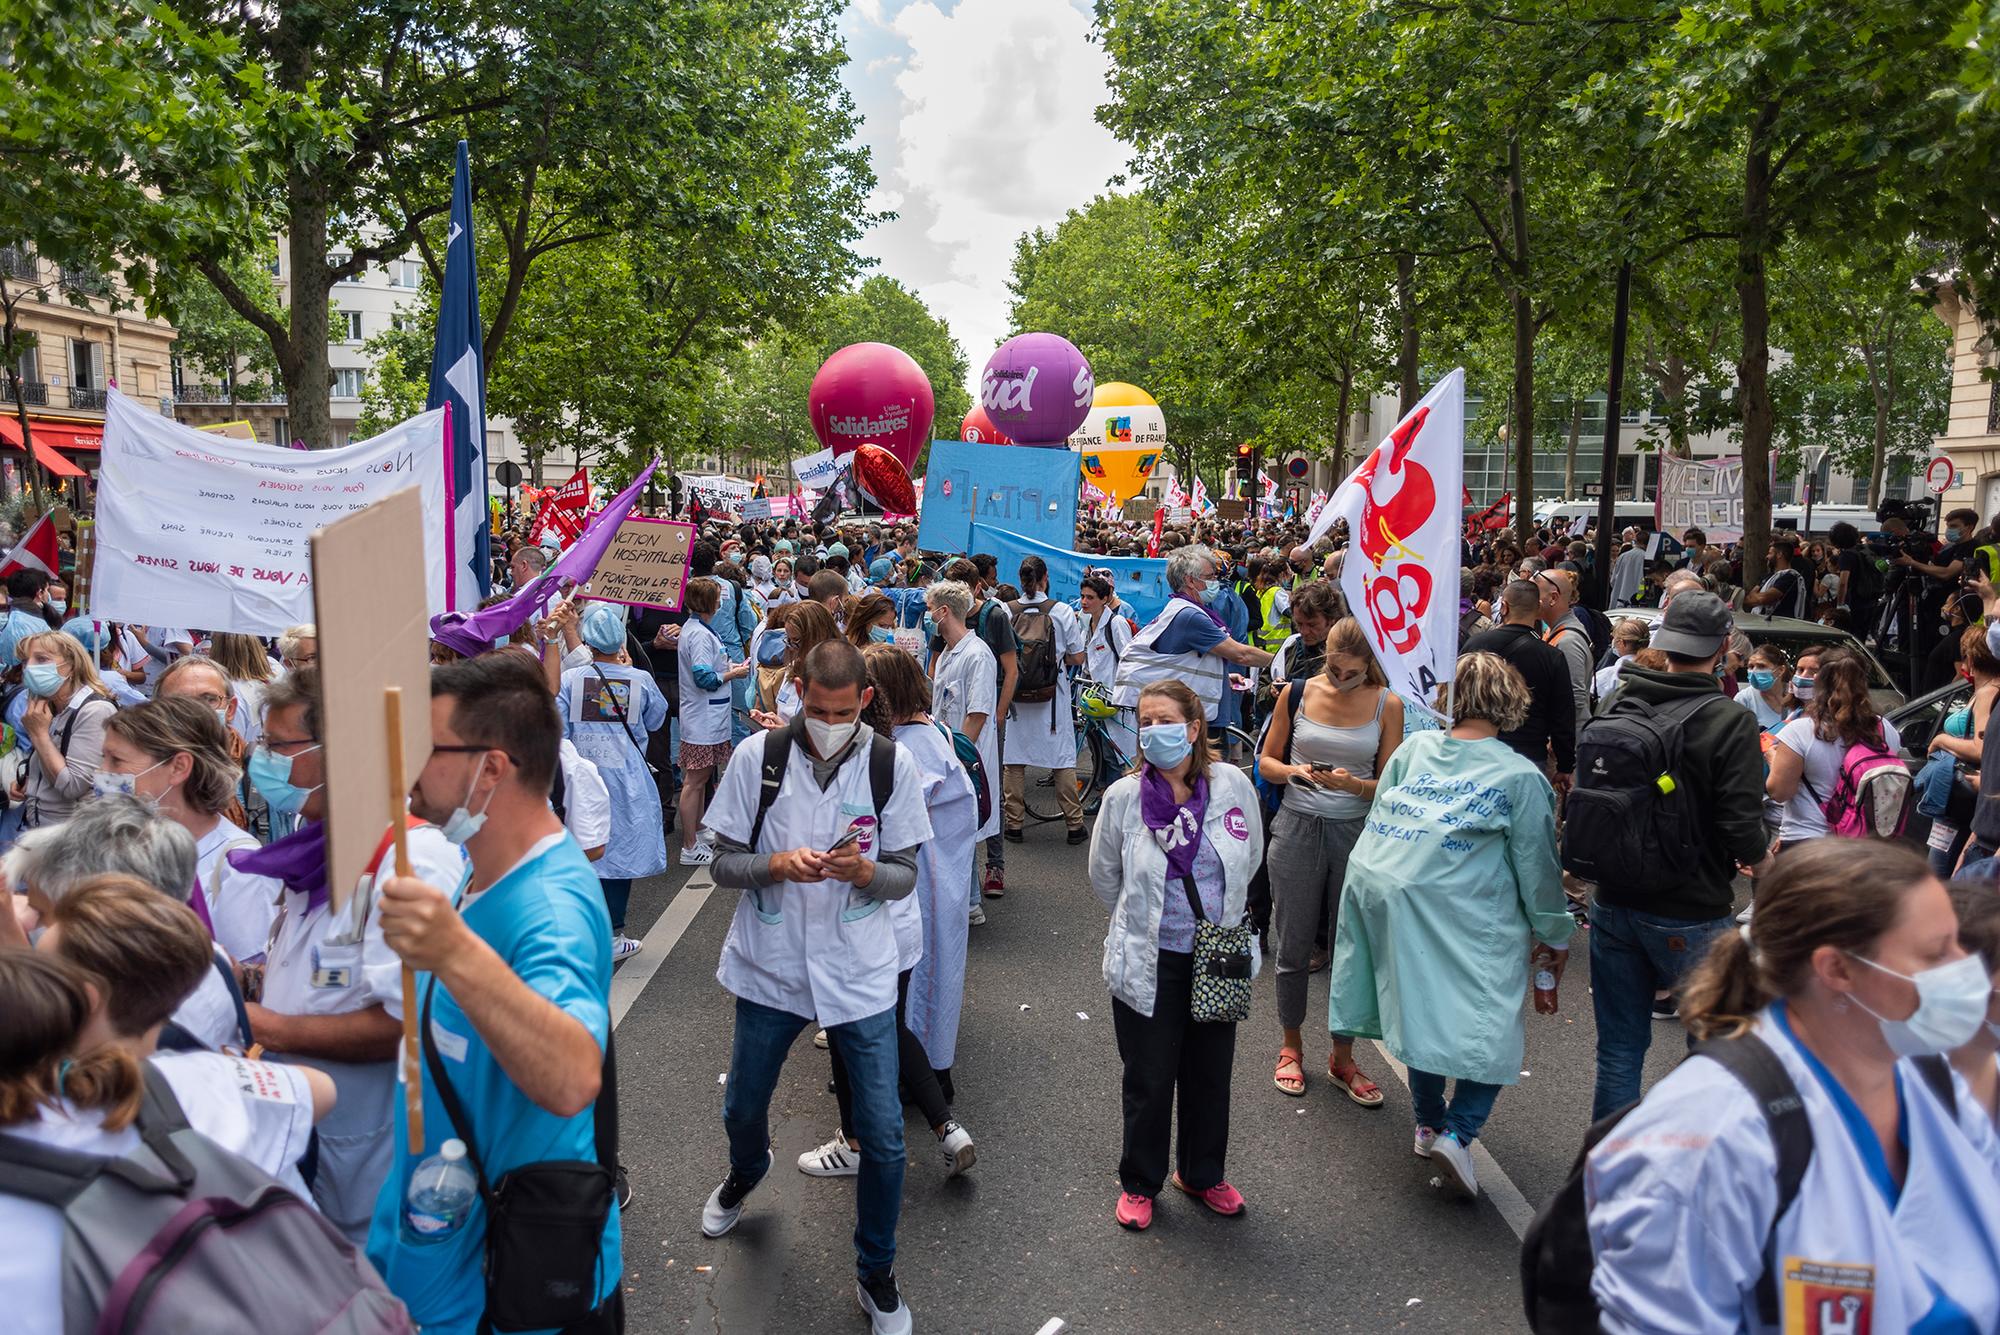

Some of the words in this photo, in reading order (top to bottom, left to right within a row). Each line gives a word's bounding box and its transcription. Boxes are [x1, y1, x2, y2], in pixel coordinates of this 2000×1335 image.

[829, 415, 908, 435] Solidaires
[1149, 422, 1158, 431] ILE
[1135, 434, 1145, 443] DE
[600, 571, 651, 586] FONCTION
[600, 585, 623, 599] MAL
[1391, 801, 1427, 818] VOUS
